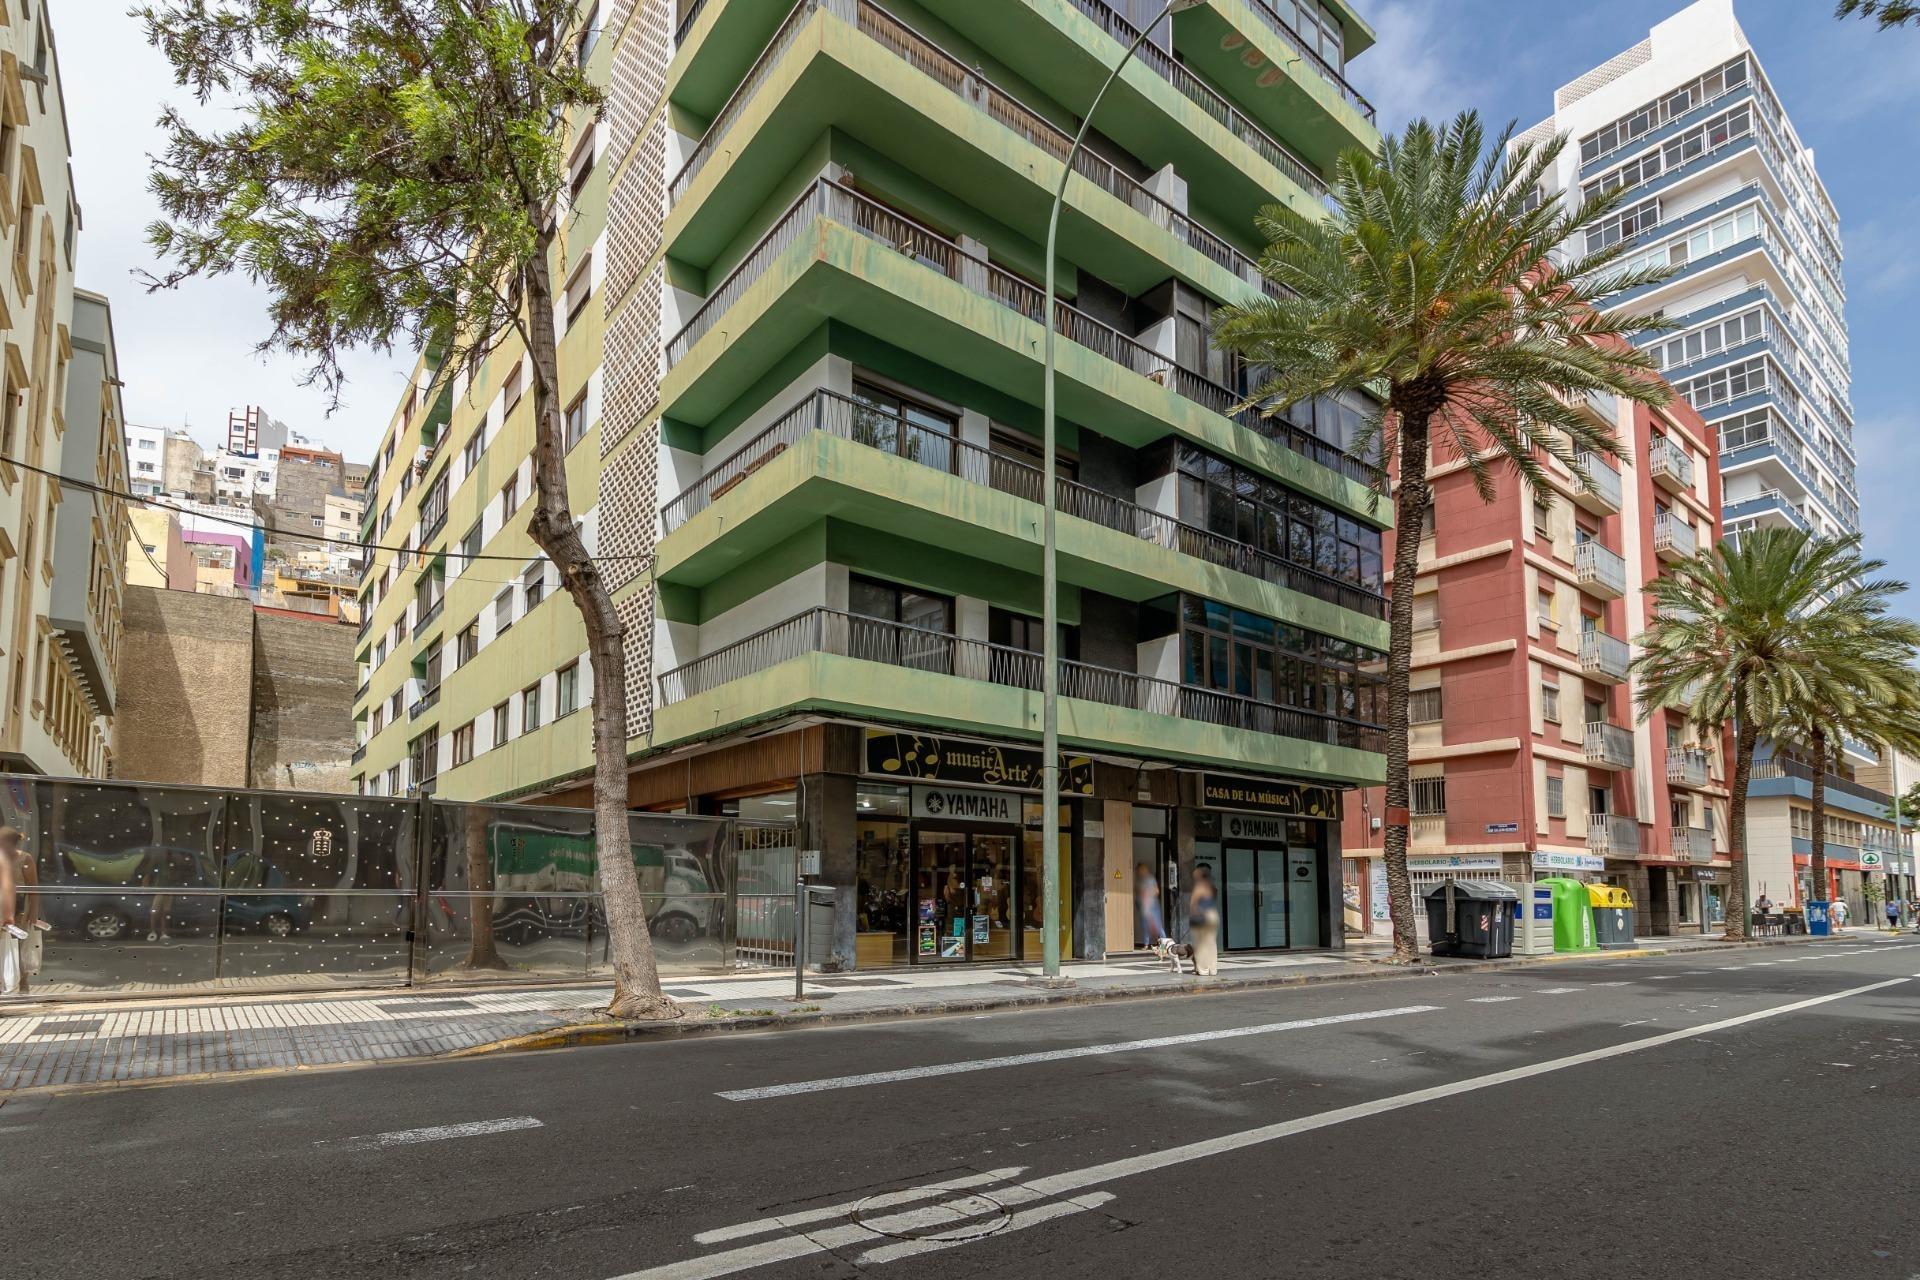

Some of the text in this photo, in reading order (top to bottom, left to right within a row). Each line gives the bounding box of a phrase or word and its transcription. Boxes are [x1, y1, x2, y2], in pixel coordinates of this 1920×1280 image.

[1206, 786, 1290, 806] CASA DE LA MÚSICA
[946, 793, 1008, 819] YAMAHA
[1243, 819, 1280, 838] YAMAHA
[1409, 858, 1447, 866] HERBOLARIO
